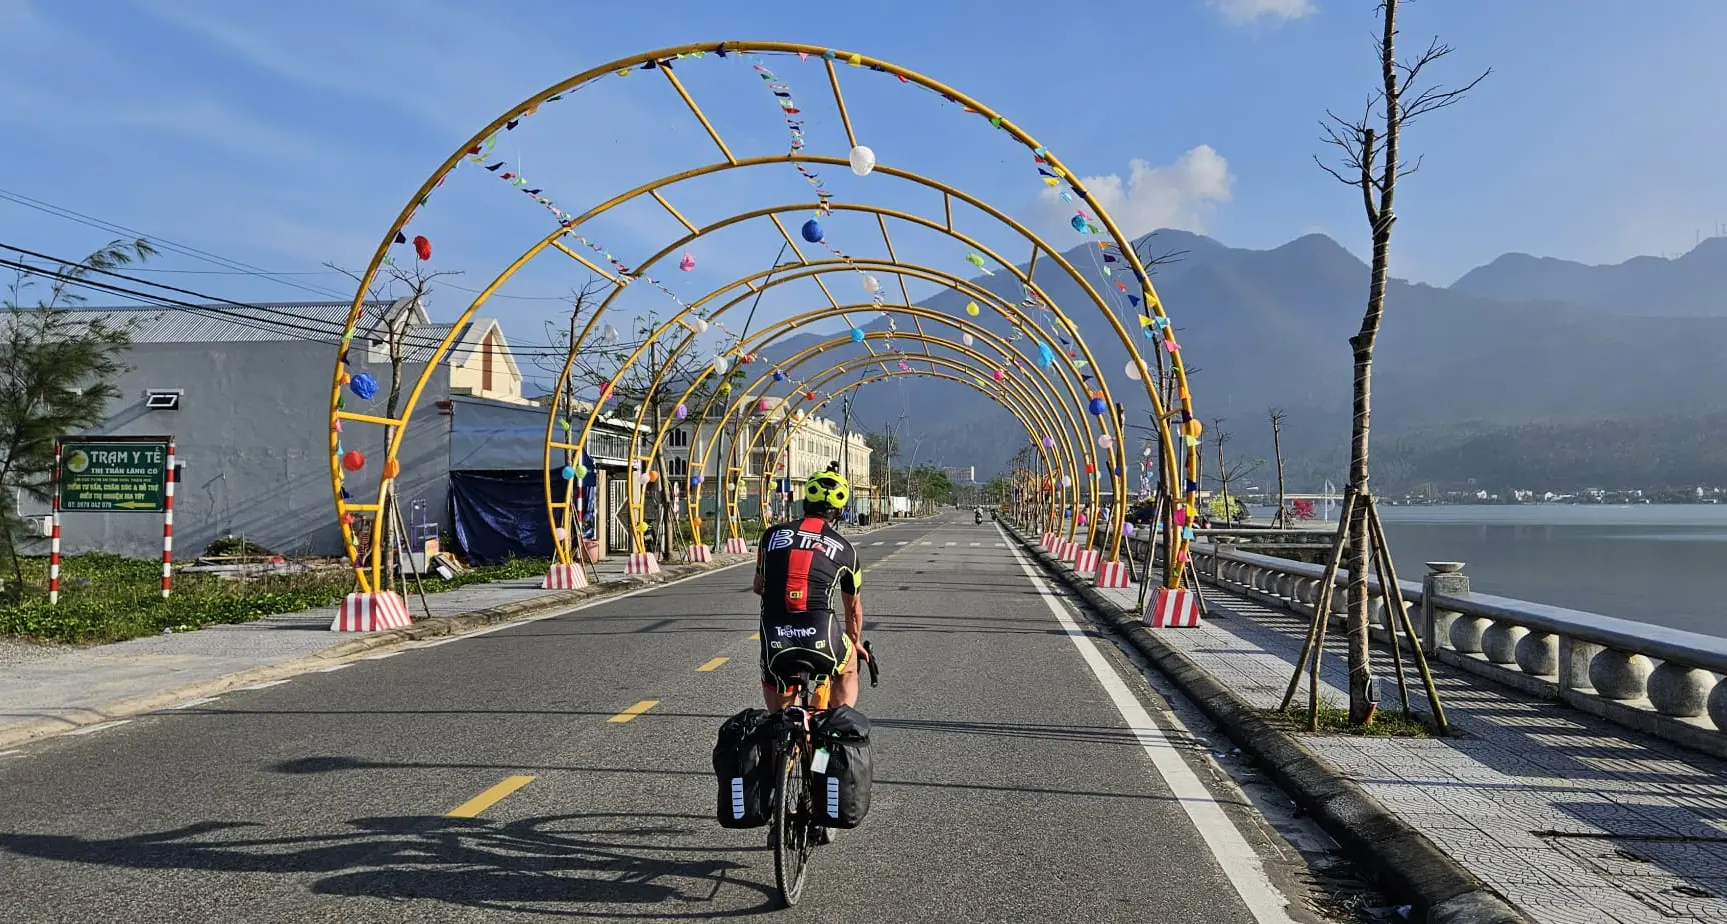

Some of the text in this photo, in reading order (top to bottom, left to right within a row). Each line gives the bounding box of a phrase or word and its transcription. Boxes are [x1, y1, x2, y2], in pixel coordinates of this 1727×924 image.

[90, 451, 128, 467] TRẠM
[132, 451, 141, 465] Y
[775, 625, 817, 638] TRENTINO
